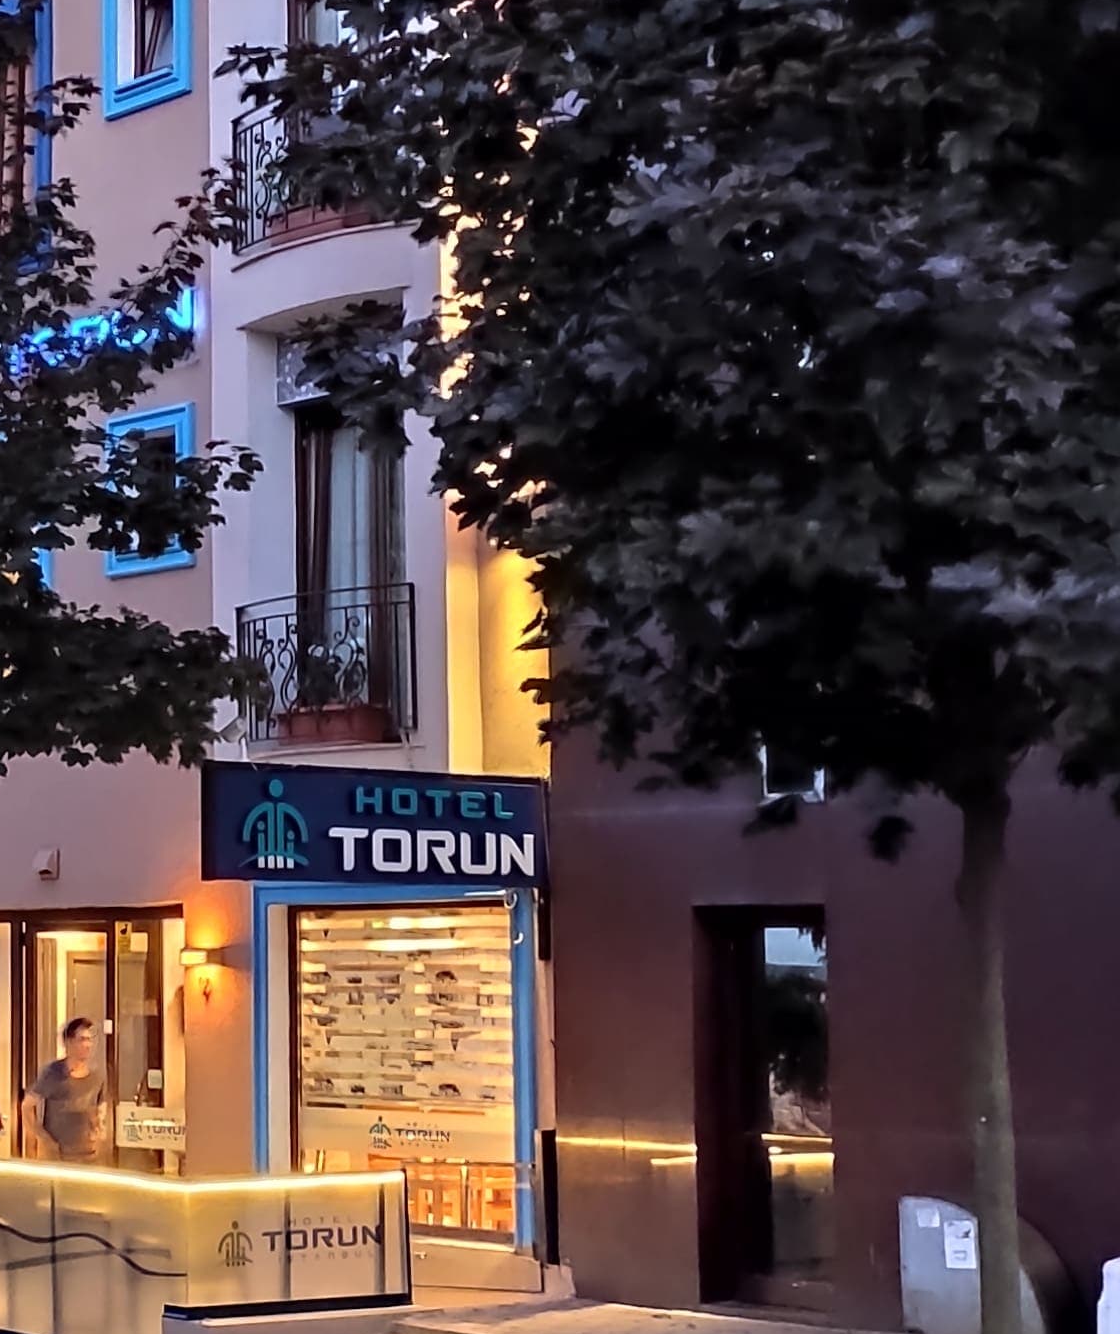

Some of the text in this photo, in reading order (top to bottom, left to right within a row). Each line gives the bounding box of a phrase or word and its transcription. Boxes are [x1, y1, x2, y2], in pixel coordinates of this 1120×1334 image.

[355, 785, 515, 819] HOTEL
[328, 826, 535, 877] TORUN
[394, 1128, 450, 1143] TORUN
[287, 1215, 354, 1227] HOTEL
[262, 1225, 384, 1252] TORUN
